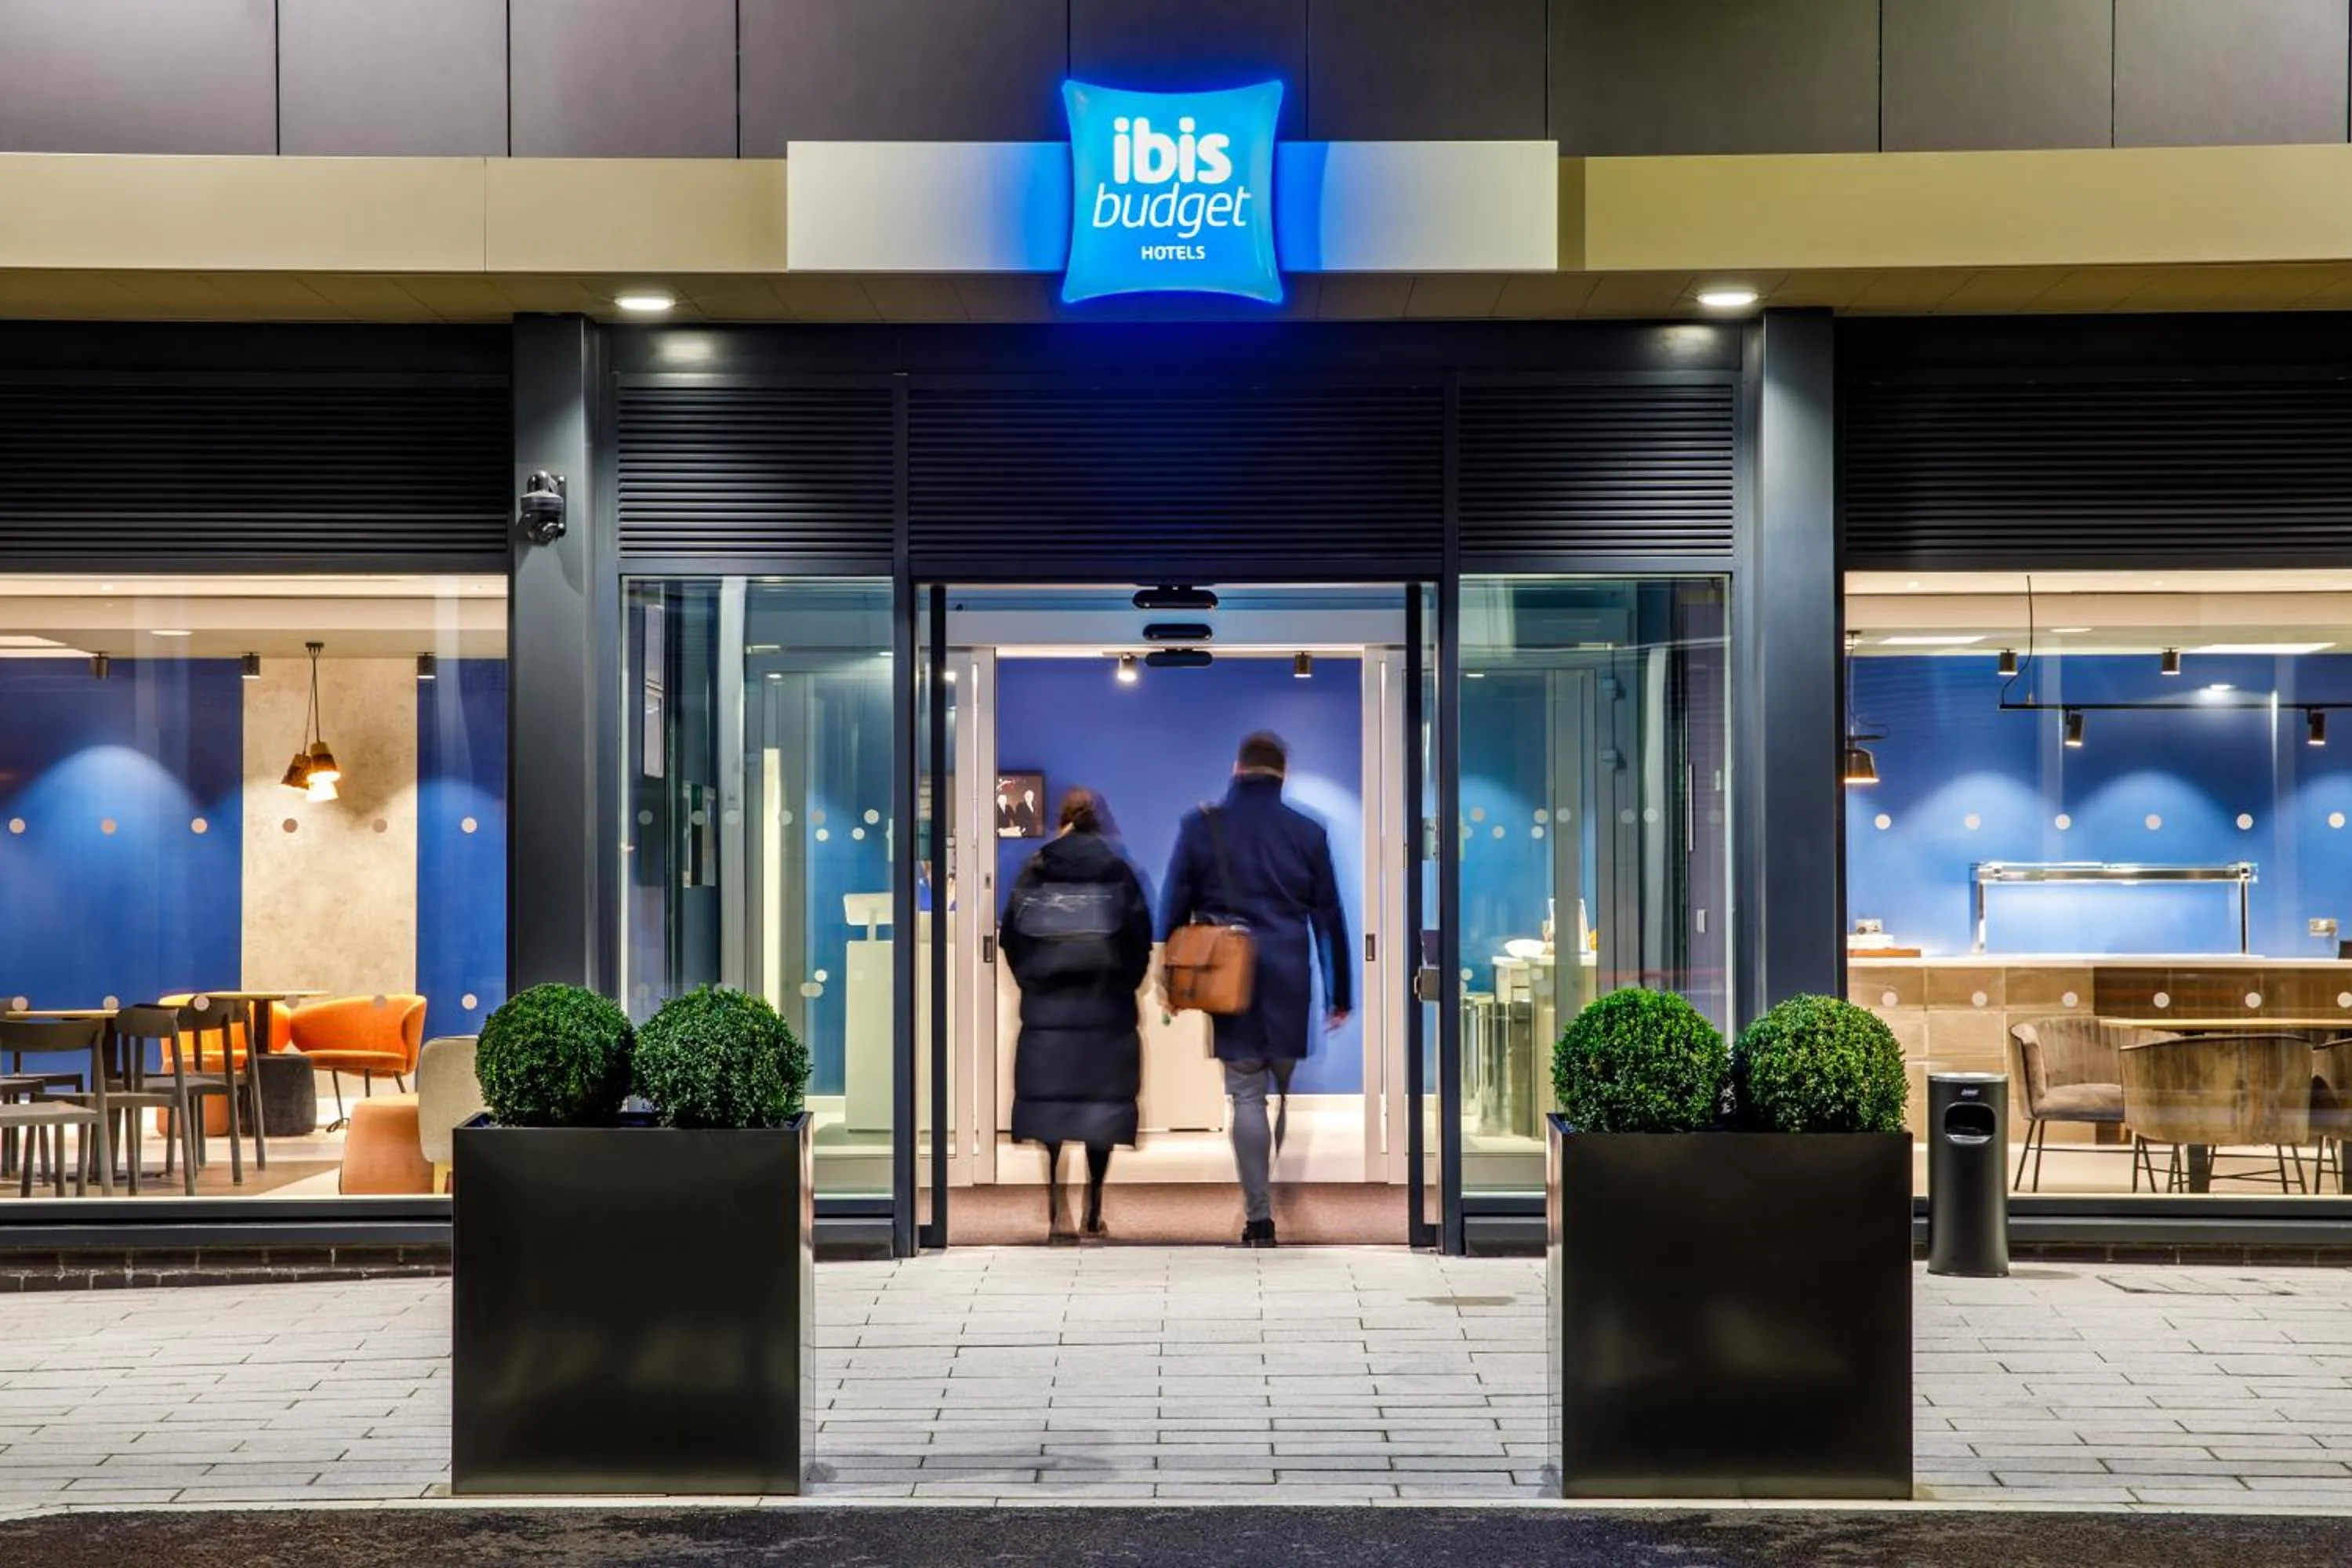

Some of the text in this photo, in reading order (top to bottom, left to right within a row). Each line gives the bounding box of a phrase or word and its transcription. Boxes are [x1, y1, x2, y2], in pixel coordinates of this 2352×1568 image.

[1113, 116, 1232, 184] ibis
[1092, 182, 1252, 238] budget
[1141, 245, 1206, 260] HOTELS
